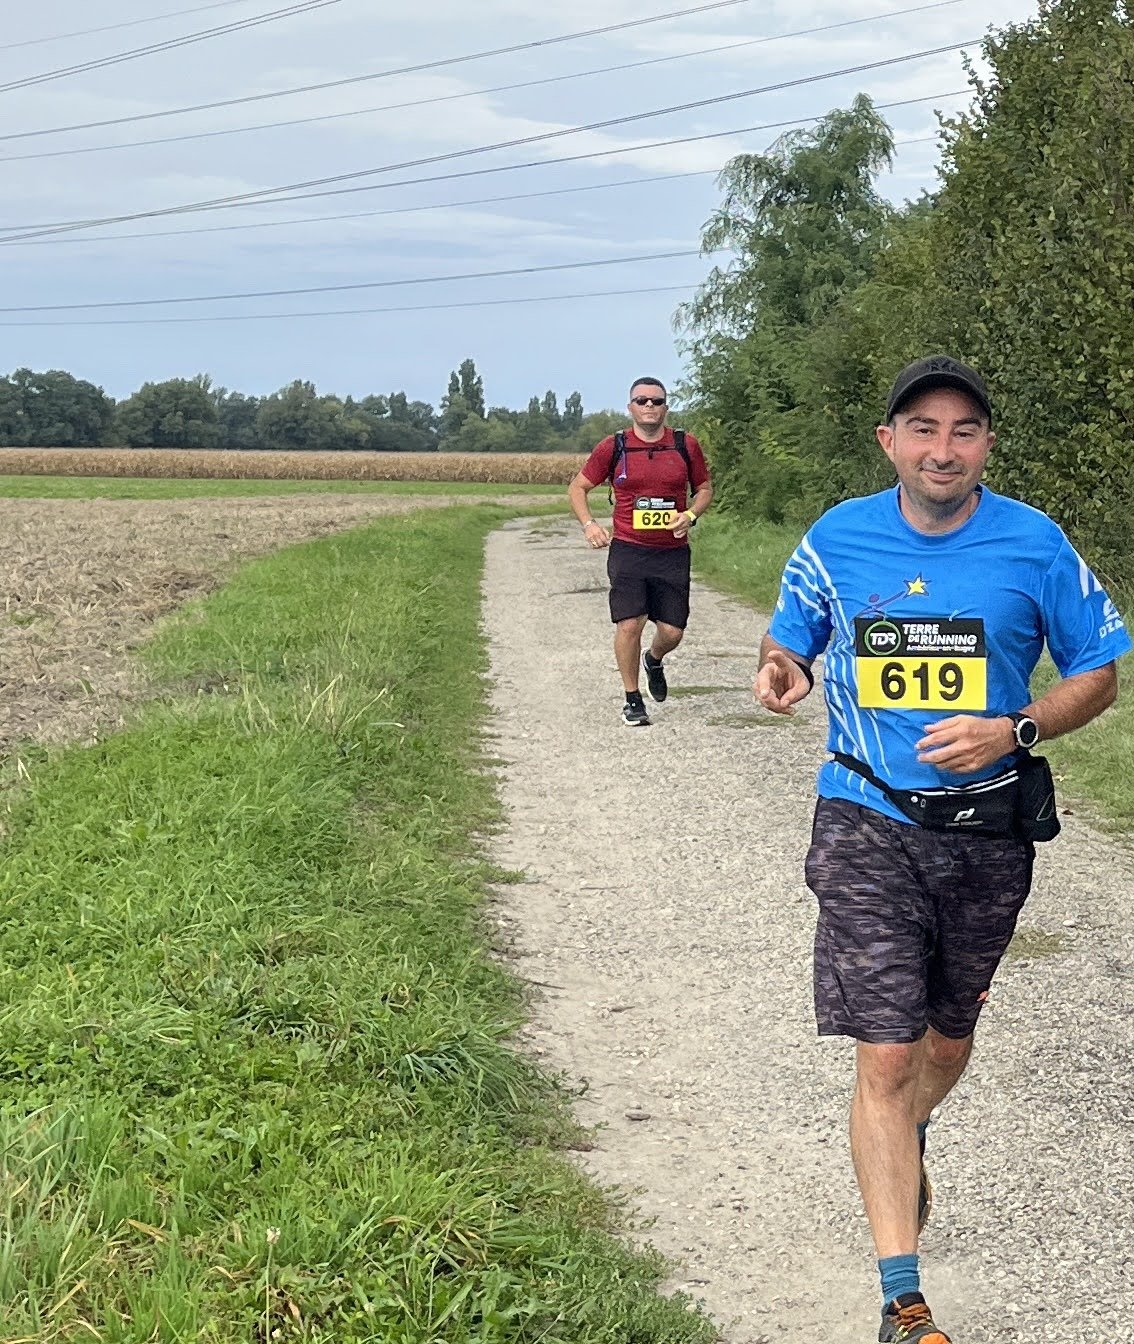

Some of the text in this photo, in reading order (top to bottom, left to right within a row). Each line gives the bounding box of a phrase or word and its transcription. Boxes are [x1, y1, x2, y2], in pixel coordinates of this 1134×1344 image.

[641, 512, 671, 526] 620
[902, 623, 940, 635] TERRE
[869, 632, 898, 646] TDR
[907, 634, 978, 646] DE RUNNING
[881, 661, 964, 702] 619
